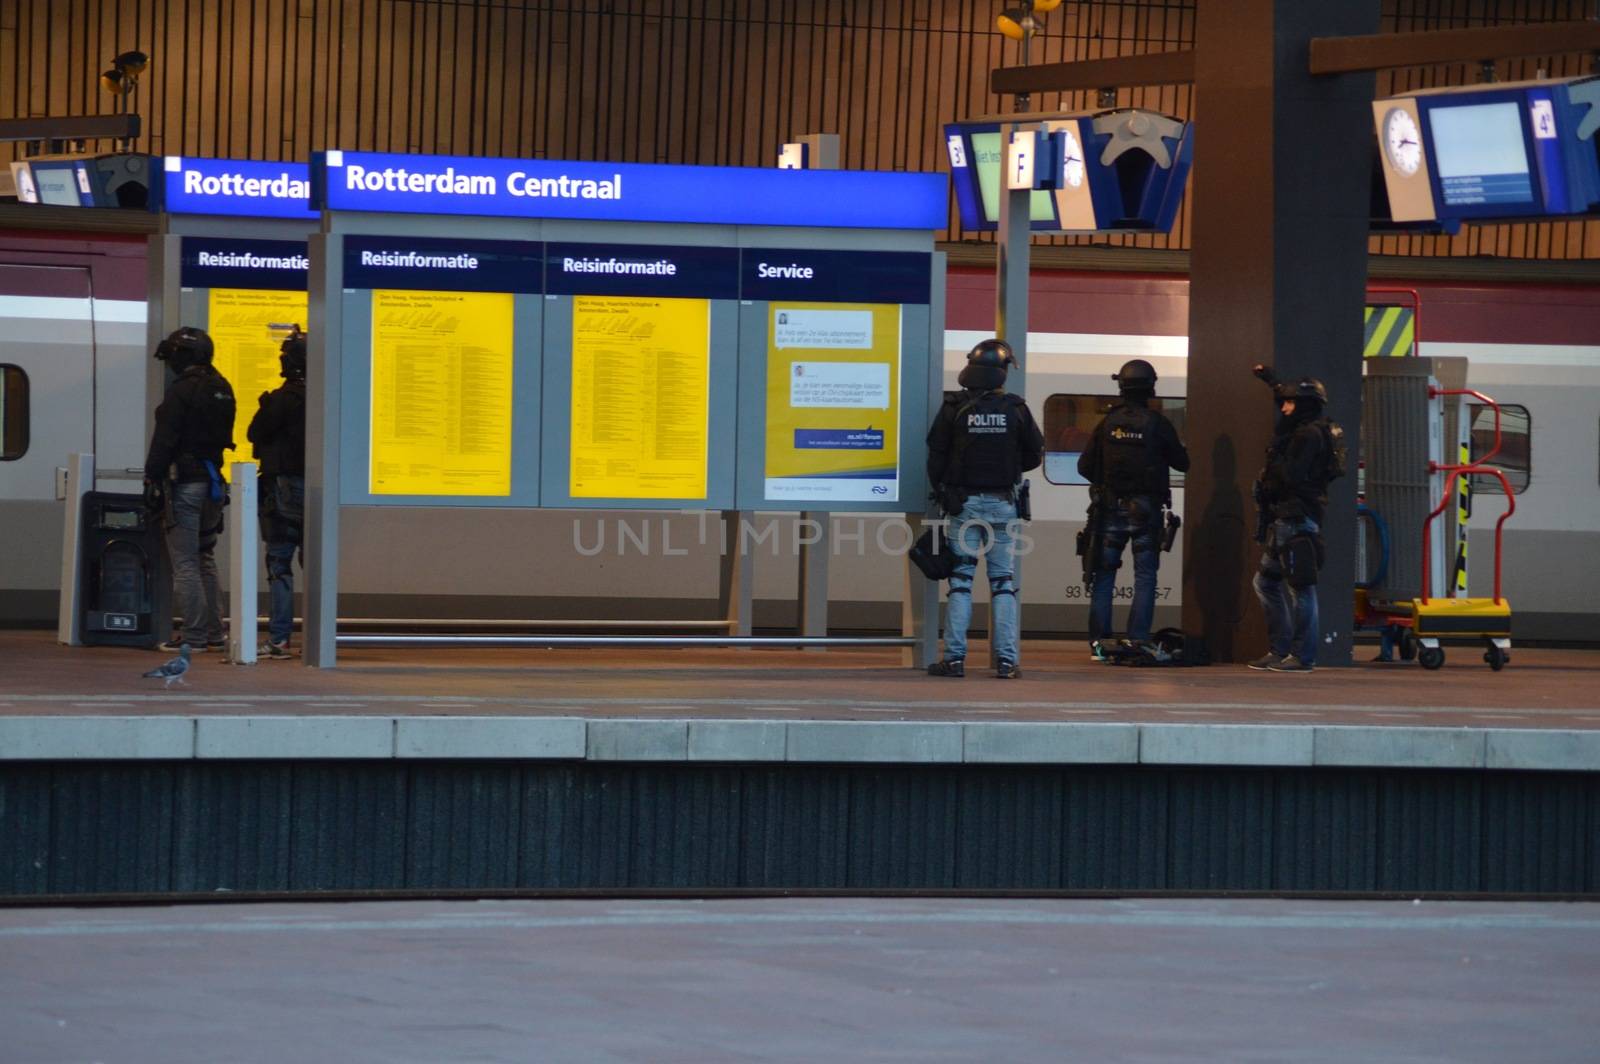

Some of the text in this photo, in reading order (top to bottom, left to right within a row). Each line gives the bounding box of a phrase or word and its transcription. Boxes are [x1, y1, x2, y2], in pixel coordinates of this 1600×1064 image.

[1017, 153, 1025, 183] F
[346, 165, 622, 200] Rotterdam Centraal
[198, 251, 309, 270] Reisinformatie
[361, 250, 478, 270] Reisinformatie
[562, 257, 676, 276] Reisinformatie
[757, 262, 814, 279] Service
[967, 413, 1007, 427] POLITIE
[1065, 585, 1081, 599] 93
